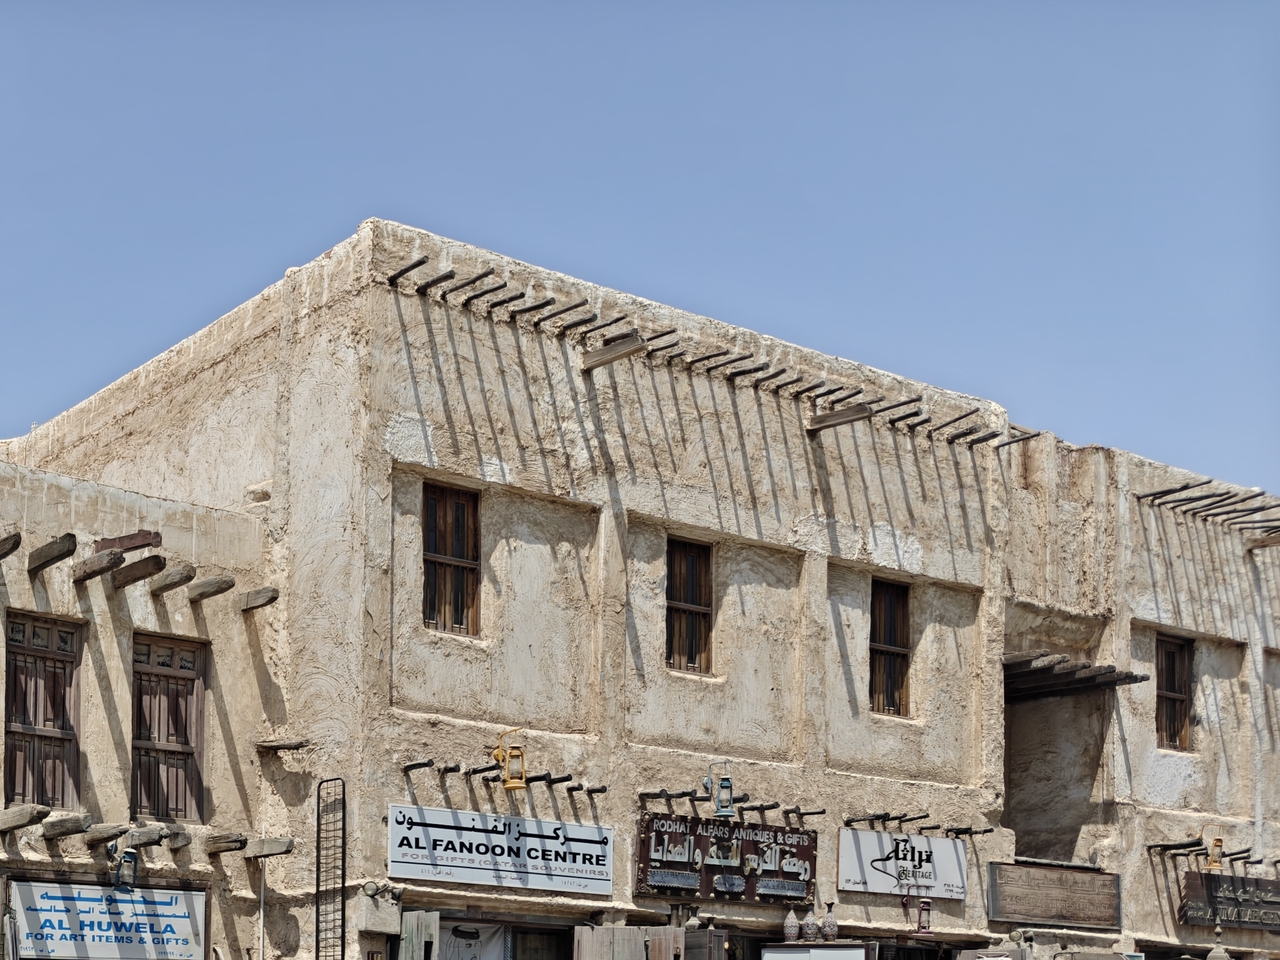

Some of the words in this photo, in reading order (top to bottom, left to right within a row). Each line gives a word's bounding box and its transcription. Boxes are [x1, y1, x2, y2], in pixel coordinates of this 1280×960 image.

[395, 808, 512, 836] الفنون
[653, 819, 691, 834] RODHAT
[696, 825, 730, 839] ALFARS
[732, 828, 775, 844] ANTIQUES
[776, 832, 784, 844] &
[784, 833, 809, 846] GIFTS
[514, 824, 609, 848] مركز
[398, 835, 427, 850] AL
[431, 838, 522, 859] FANOON
[526, 847, 607, 867] CENTRE
[401, 852, 432, 862] FOR
[436, 854, 475, 865] GIFTS
[531, 863, 609, 879] SOUVENIRS)
[26, 932, 54, 941] FOR
[58, 933, 88, 943] ART
[91, 934, 133, 944] ITEMS
[138, 936, 147, 945] &
[152, 936, 190, 946] GIFTS
[40, 918, 71, 931] AL
[79, 920, 176, 935] HUWELA
